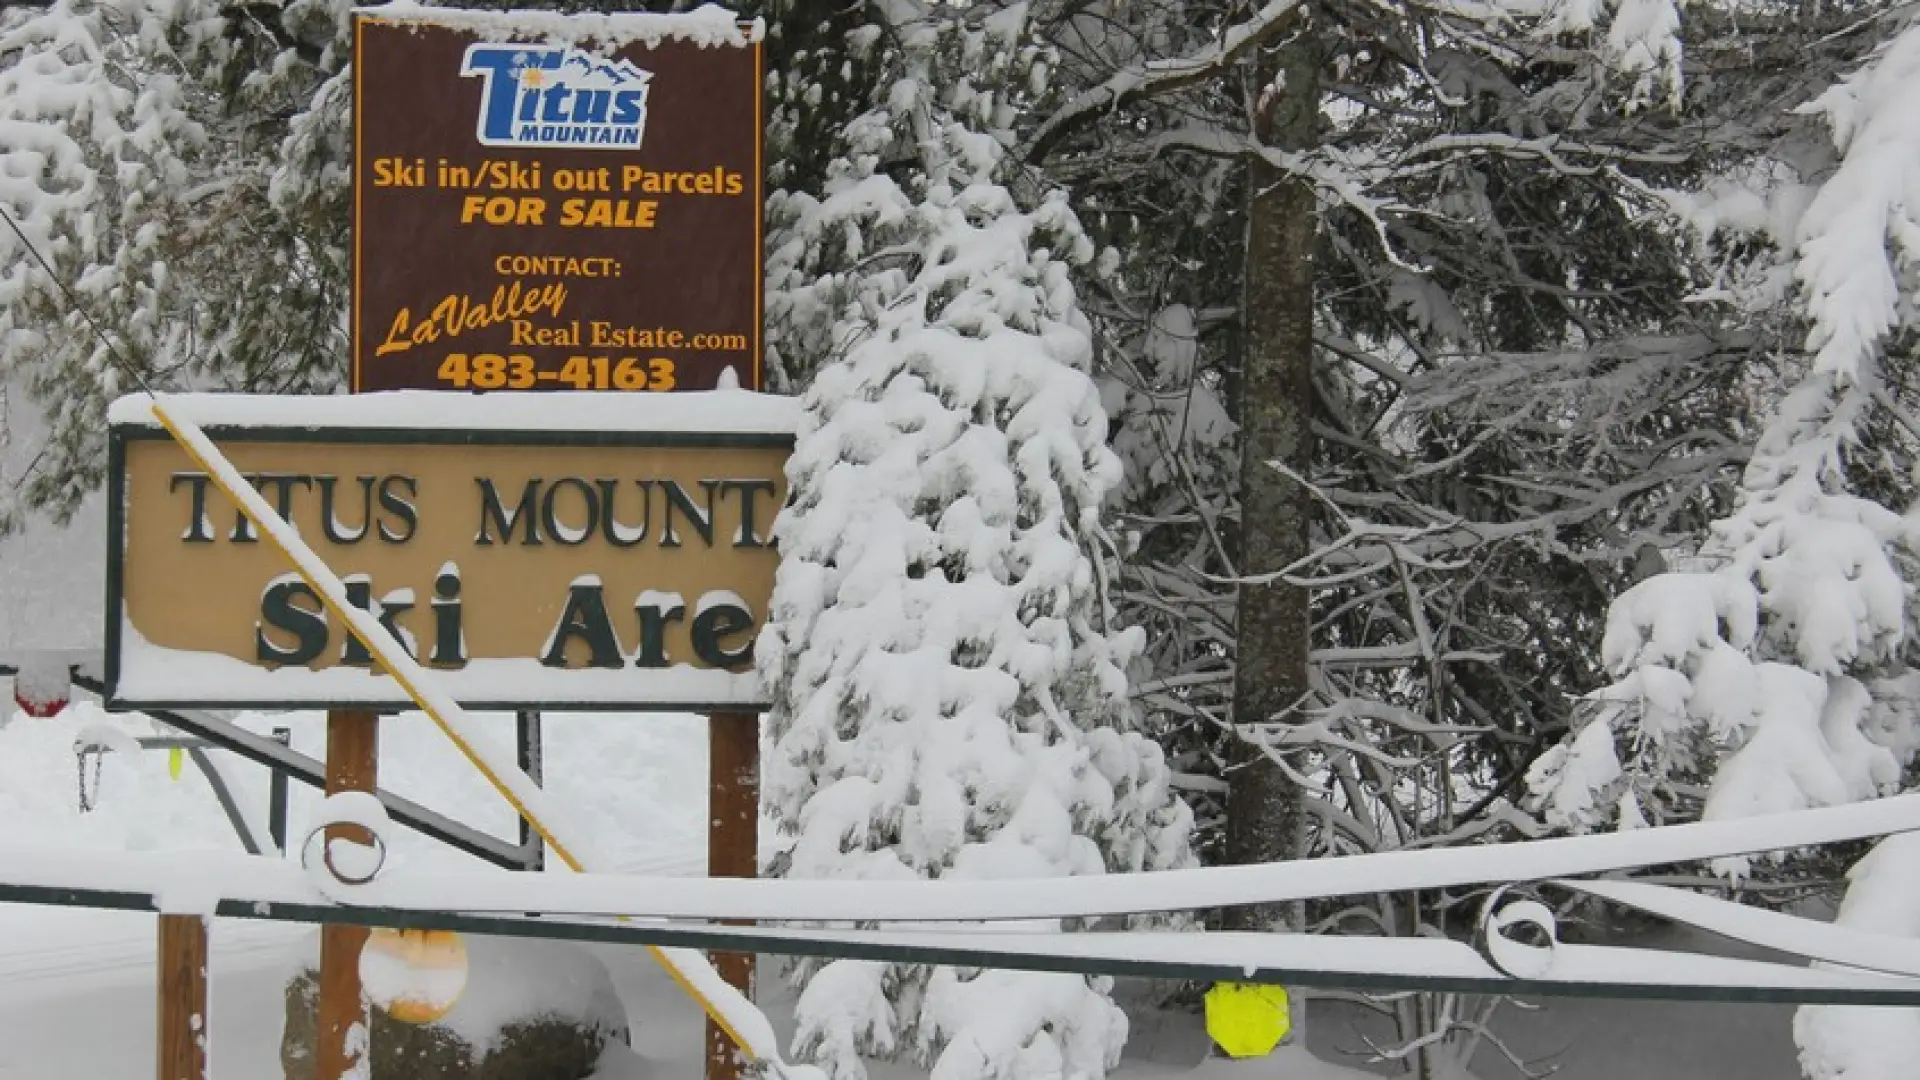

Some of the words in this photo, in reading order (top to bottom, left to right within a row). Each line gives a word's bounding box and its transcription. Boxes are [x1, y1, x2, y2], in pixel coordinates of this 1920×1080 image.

[470, 50, 643, 139] Titus
[519, 125, 639, 144] MOUNTAIN
[373, 159, 425, 187] Ski
[439, 160, 540, 190] in/Ski
[553, 167, 610, 192] out
[623, 165, 743, 194] Parcels
[460, 196, 546, 225] FOR
[560, 199, 658, 228] SALE
[495, 255, 622, 277] CONTACT:
[375, 281, 568, 357] LaValley
[510, 320, 580, 347] Real
[591, 322, 748, 350] Estate.com
[437, 353, 675, 391] 483-4163
[170, 472, 418, 545] TITUS
[474, 476, 779, 549] MOUNT
[256, 572, 468, 666] Ski
